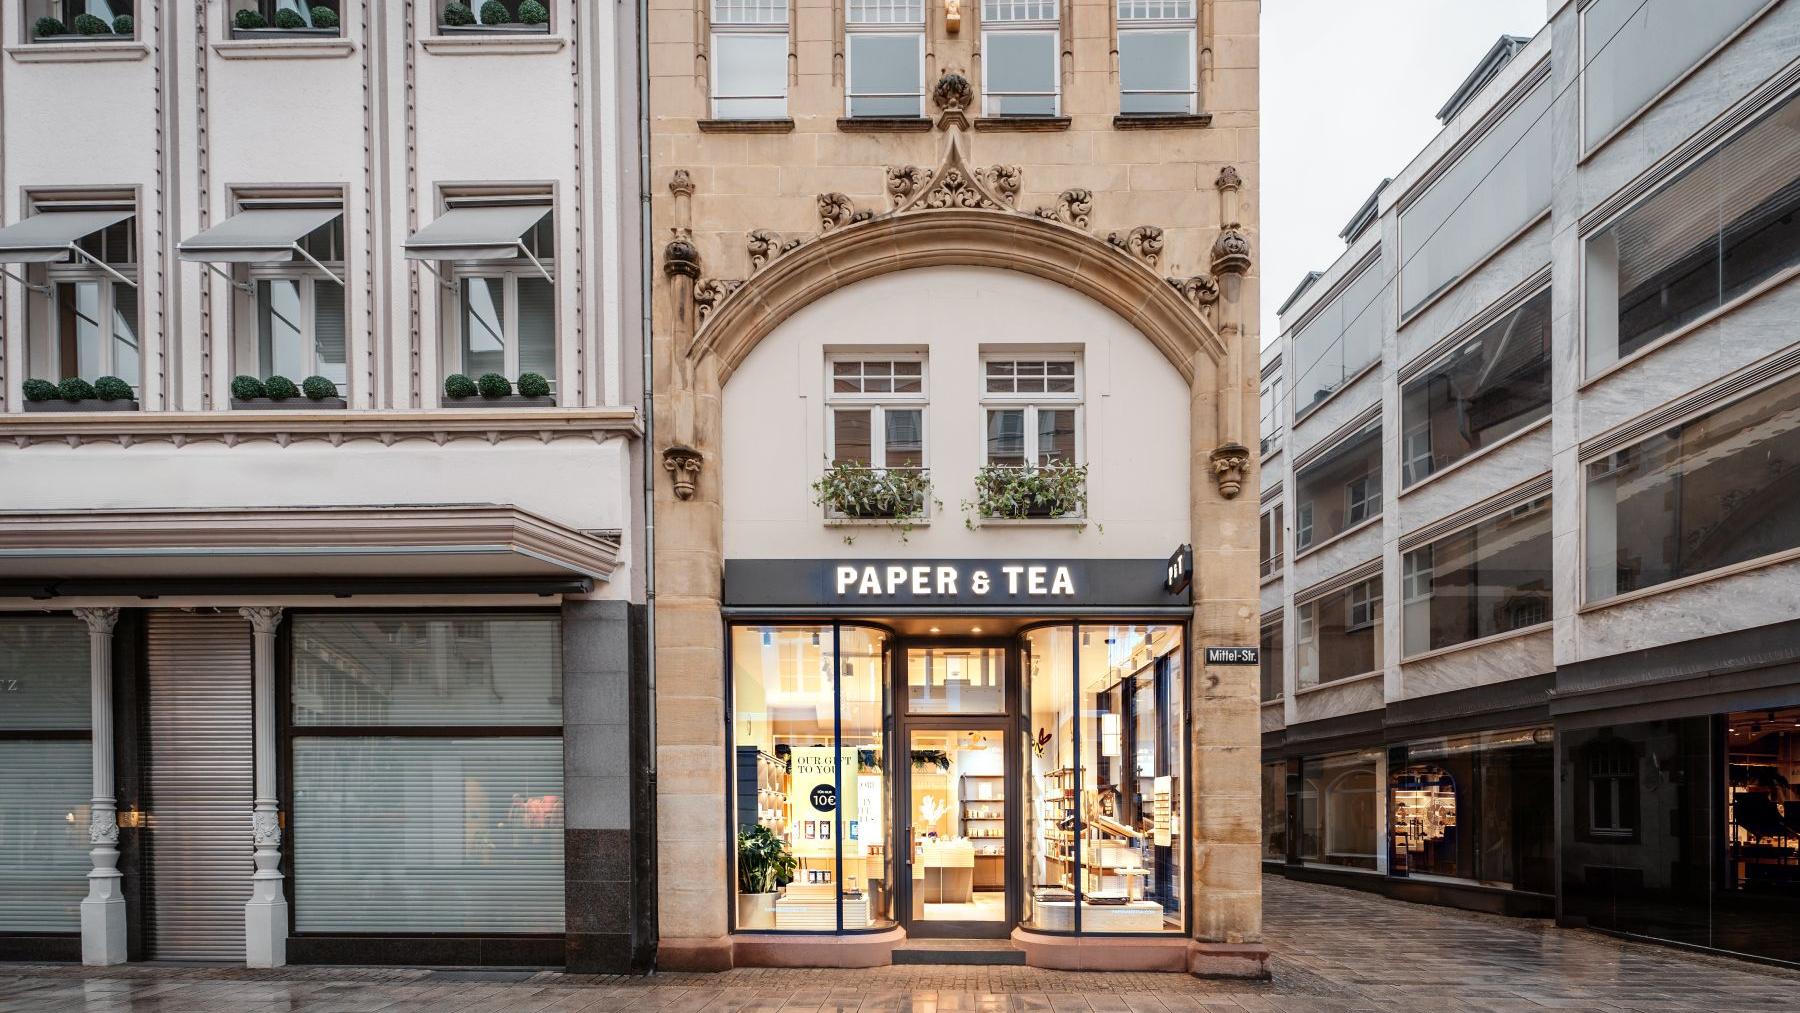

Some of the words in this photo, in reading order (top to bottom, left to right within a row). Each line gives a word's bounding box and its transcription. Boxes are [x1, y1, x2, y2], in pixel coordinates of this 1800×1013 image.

[836, 566, 958, 595] PAPER
[971, 570, 991, 595] &
[1002, 566, 1075, 595] TEA
[1209, 649, 1257, 662] Mittel-Str.
[797, 756, 822, 765] OUR
[824, 756, 852, 765] GT
[797, 765, 813, 774] TO
[813, 795, 836, 806] 10€
